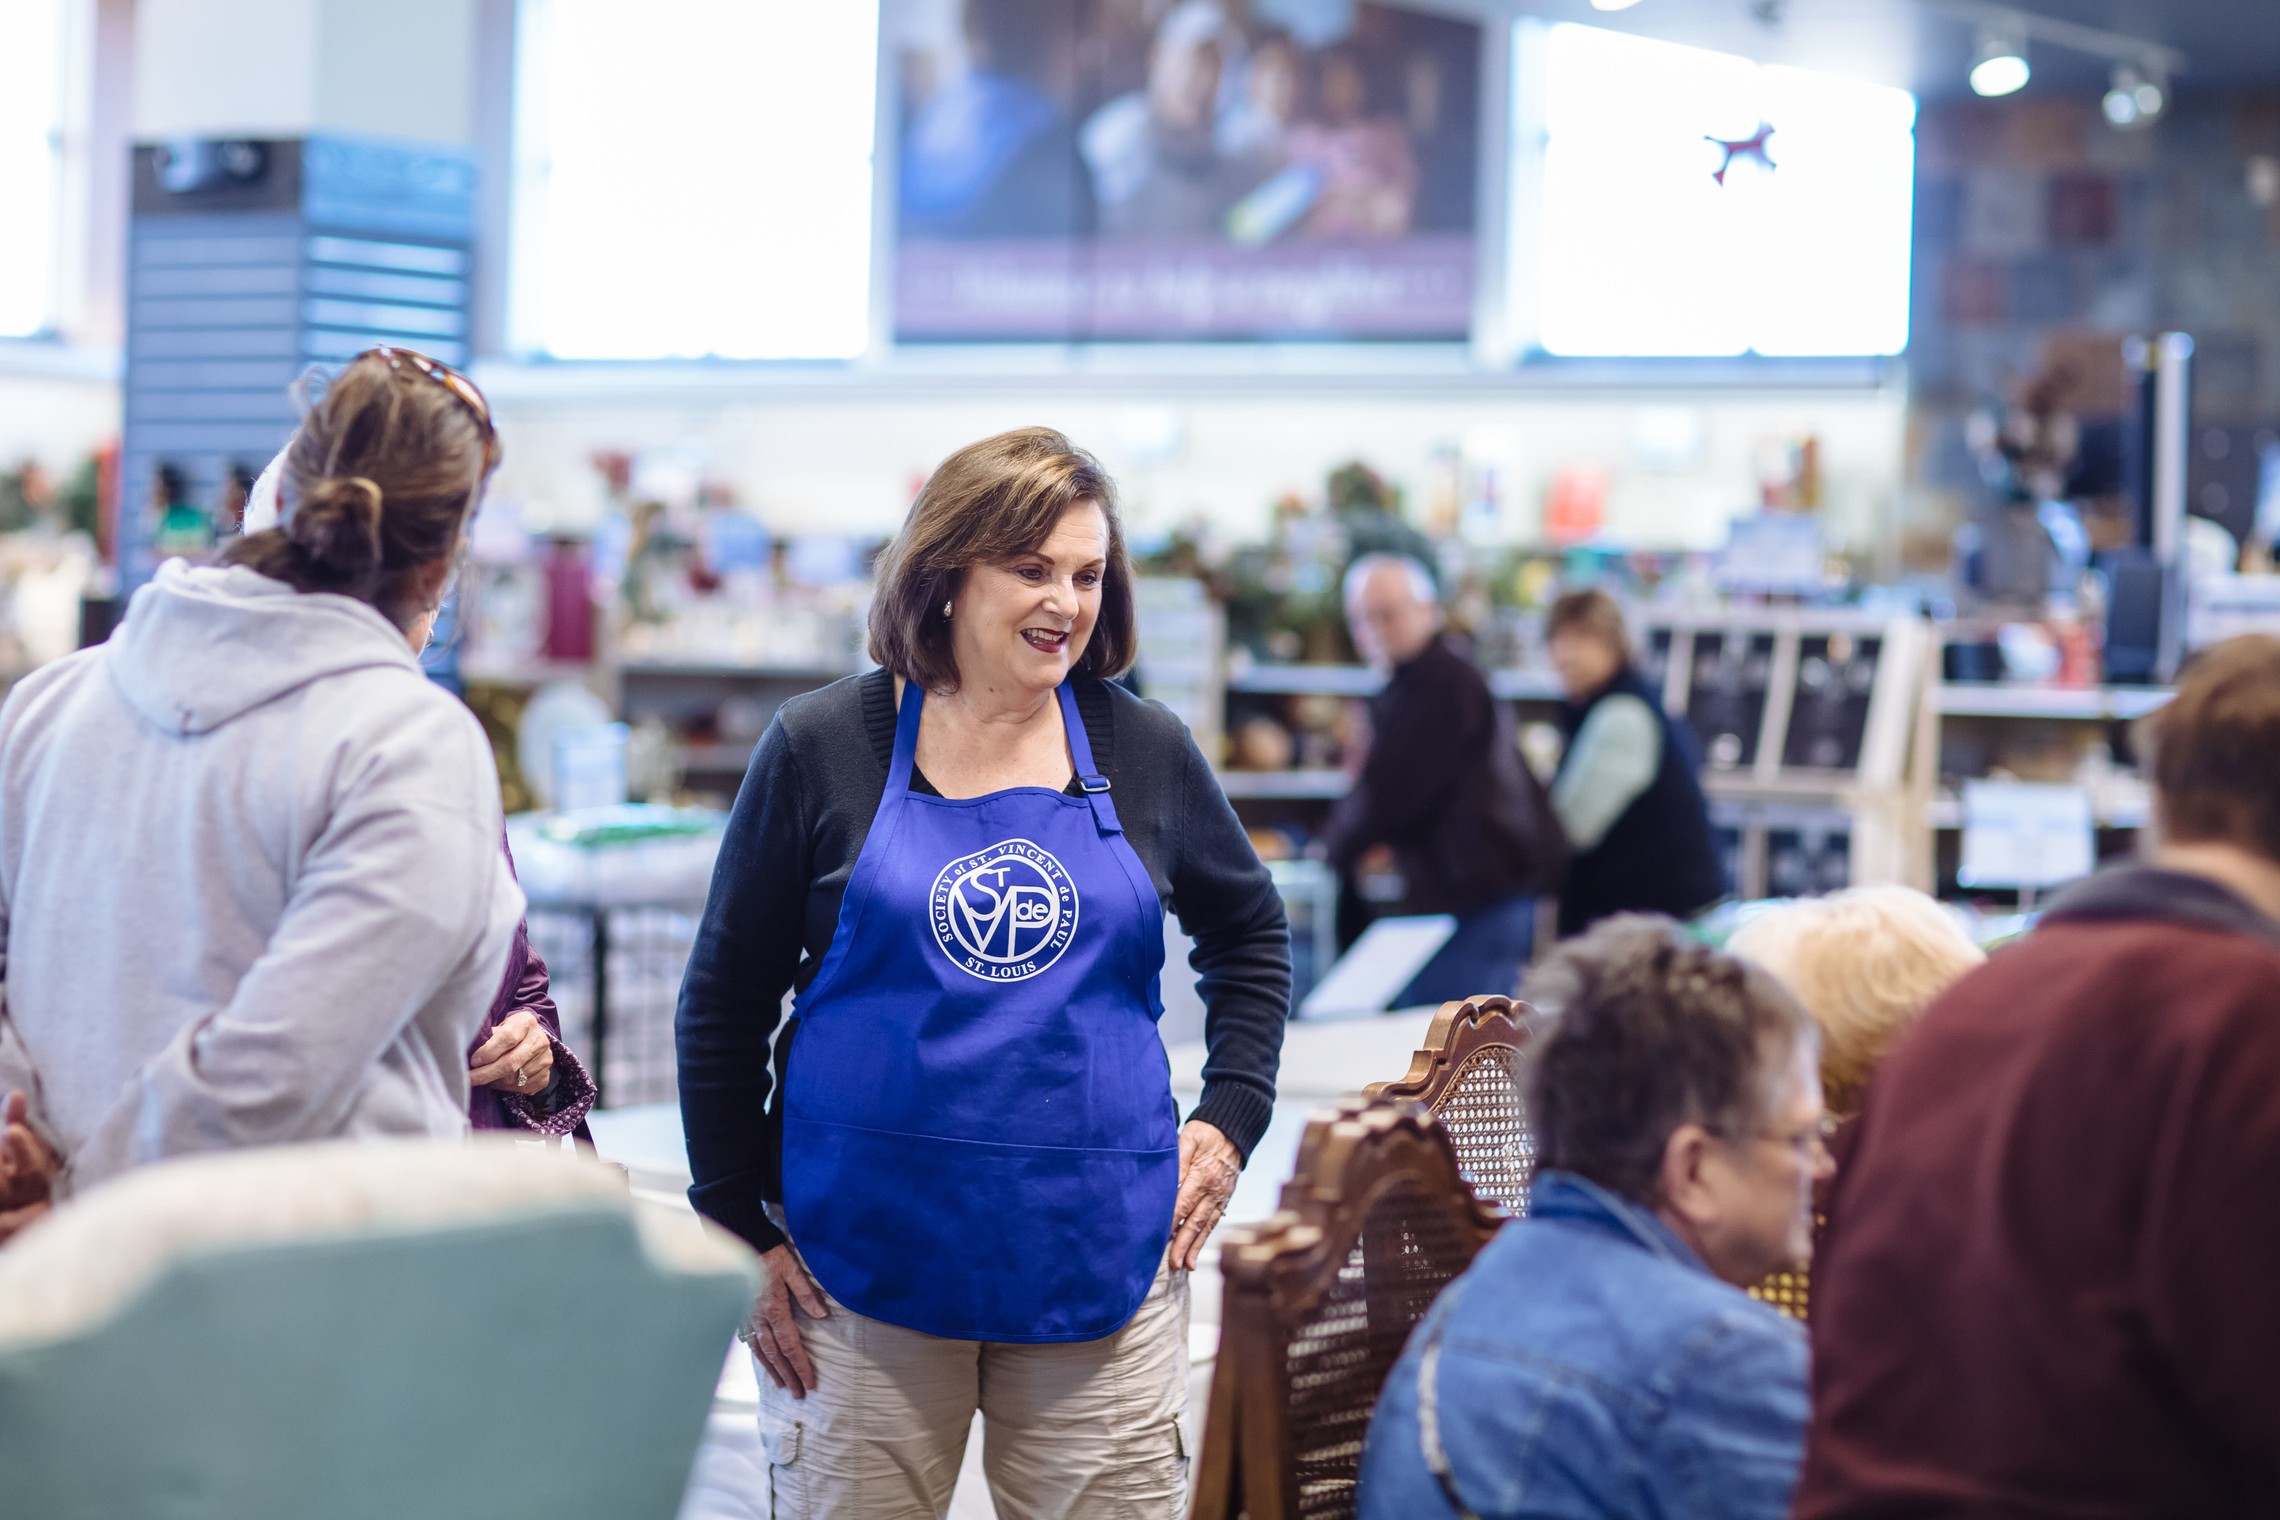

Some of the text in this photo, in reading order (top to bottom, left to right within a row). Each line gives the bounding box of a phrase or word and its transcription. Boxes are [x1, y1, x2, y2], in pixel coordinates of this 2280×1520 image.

[935, 844, 1073, 950] SOCIETY of ST. VINCENT de PAUL
[965, 956, 1037, 978] ST. LOUIS
